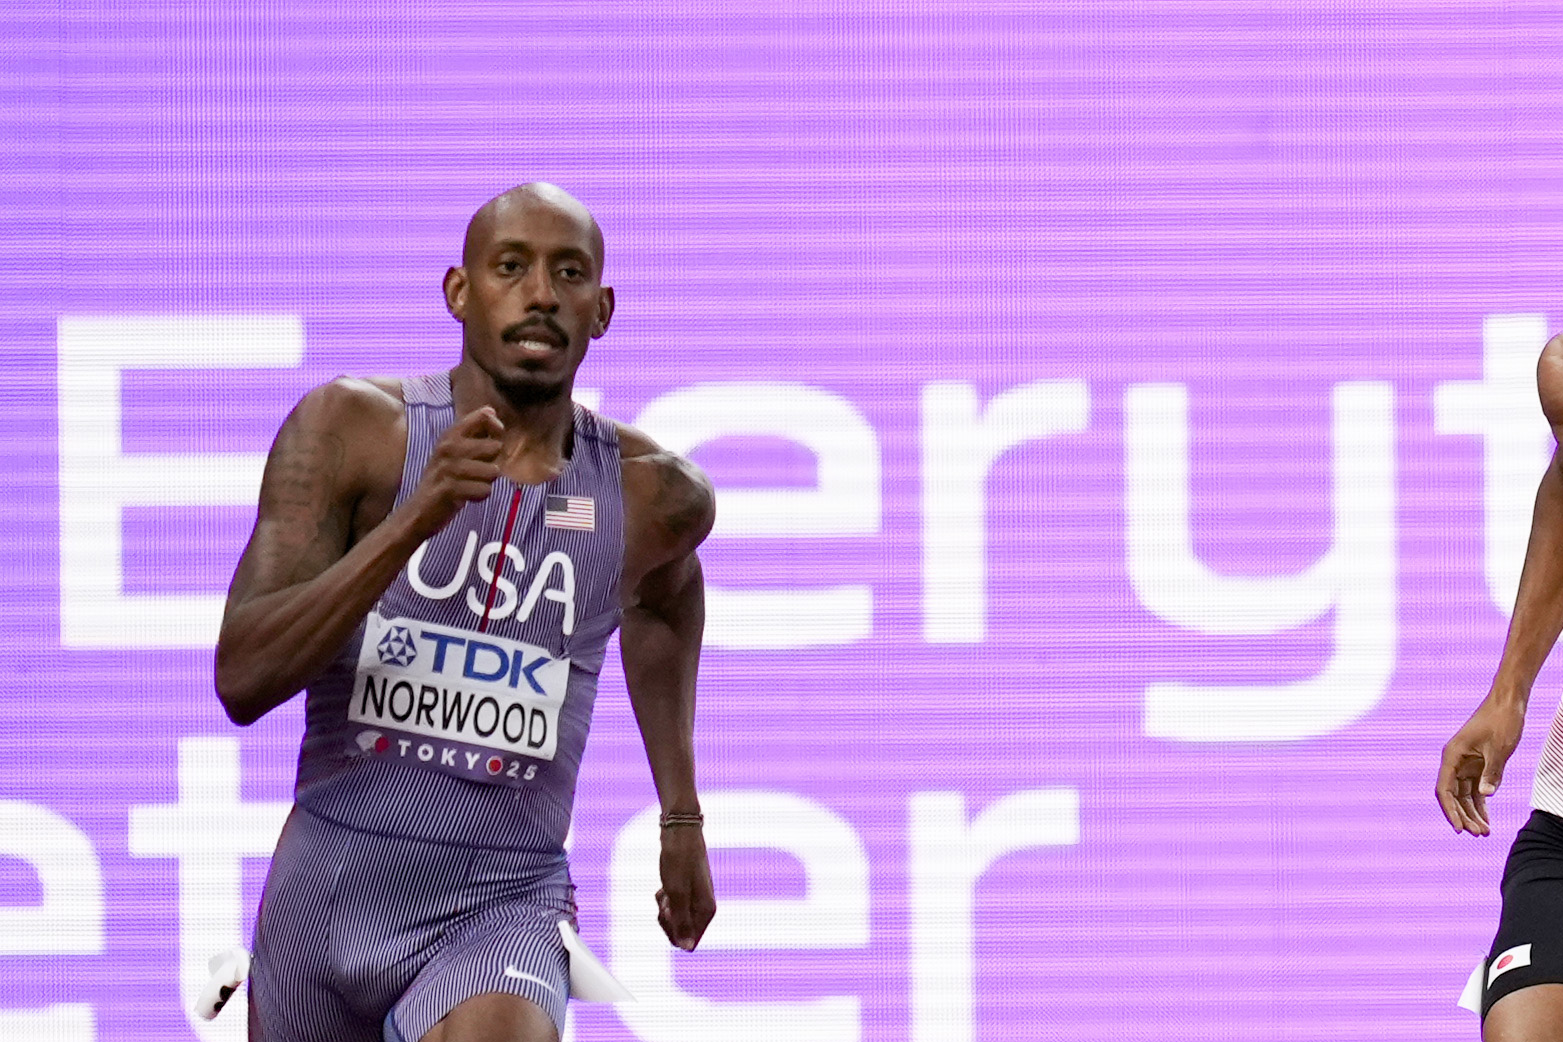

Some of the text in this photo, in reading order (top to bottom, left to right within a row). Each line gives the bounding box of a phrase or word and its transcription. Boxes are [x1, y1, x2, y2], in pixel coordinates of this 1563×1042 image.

[407, 530, 576, 635] USA
[420, 630, 551, 696] TDK
[360, 675, 548, 750] NORWOOD
